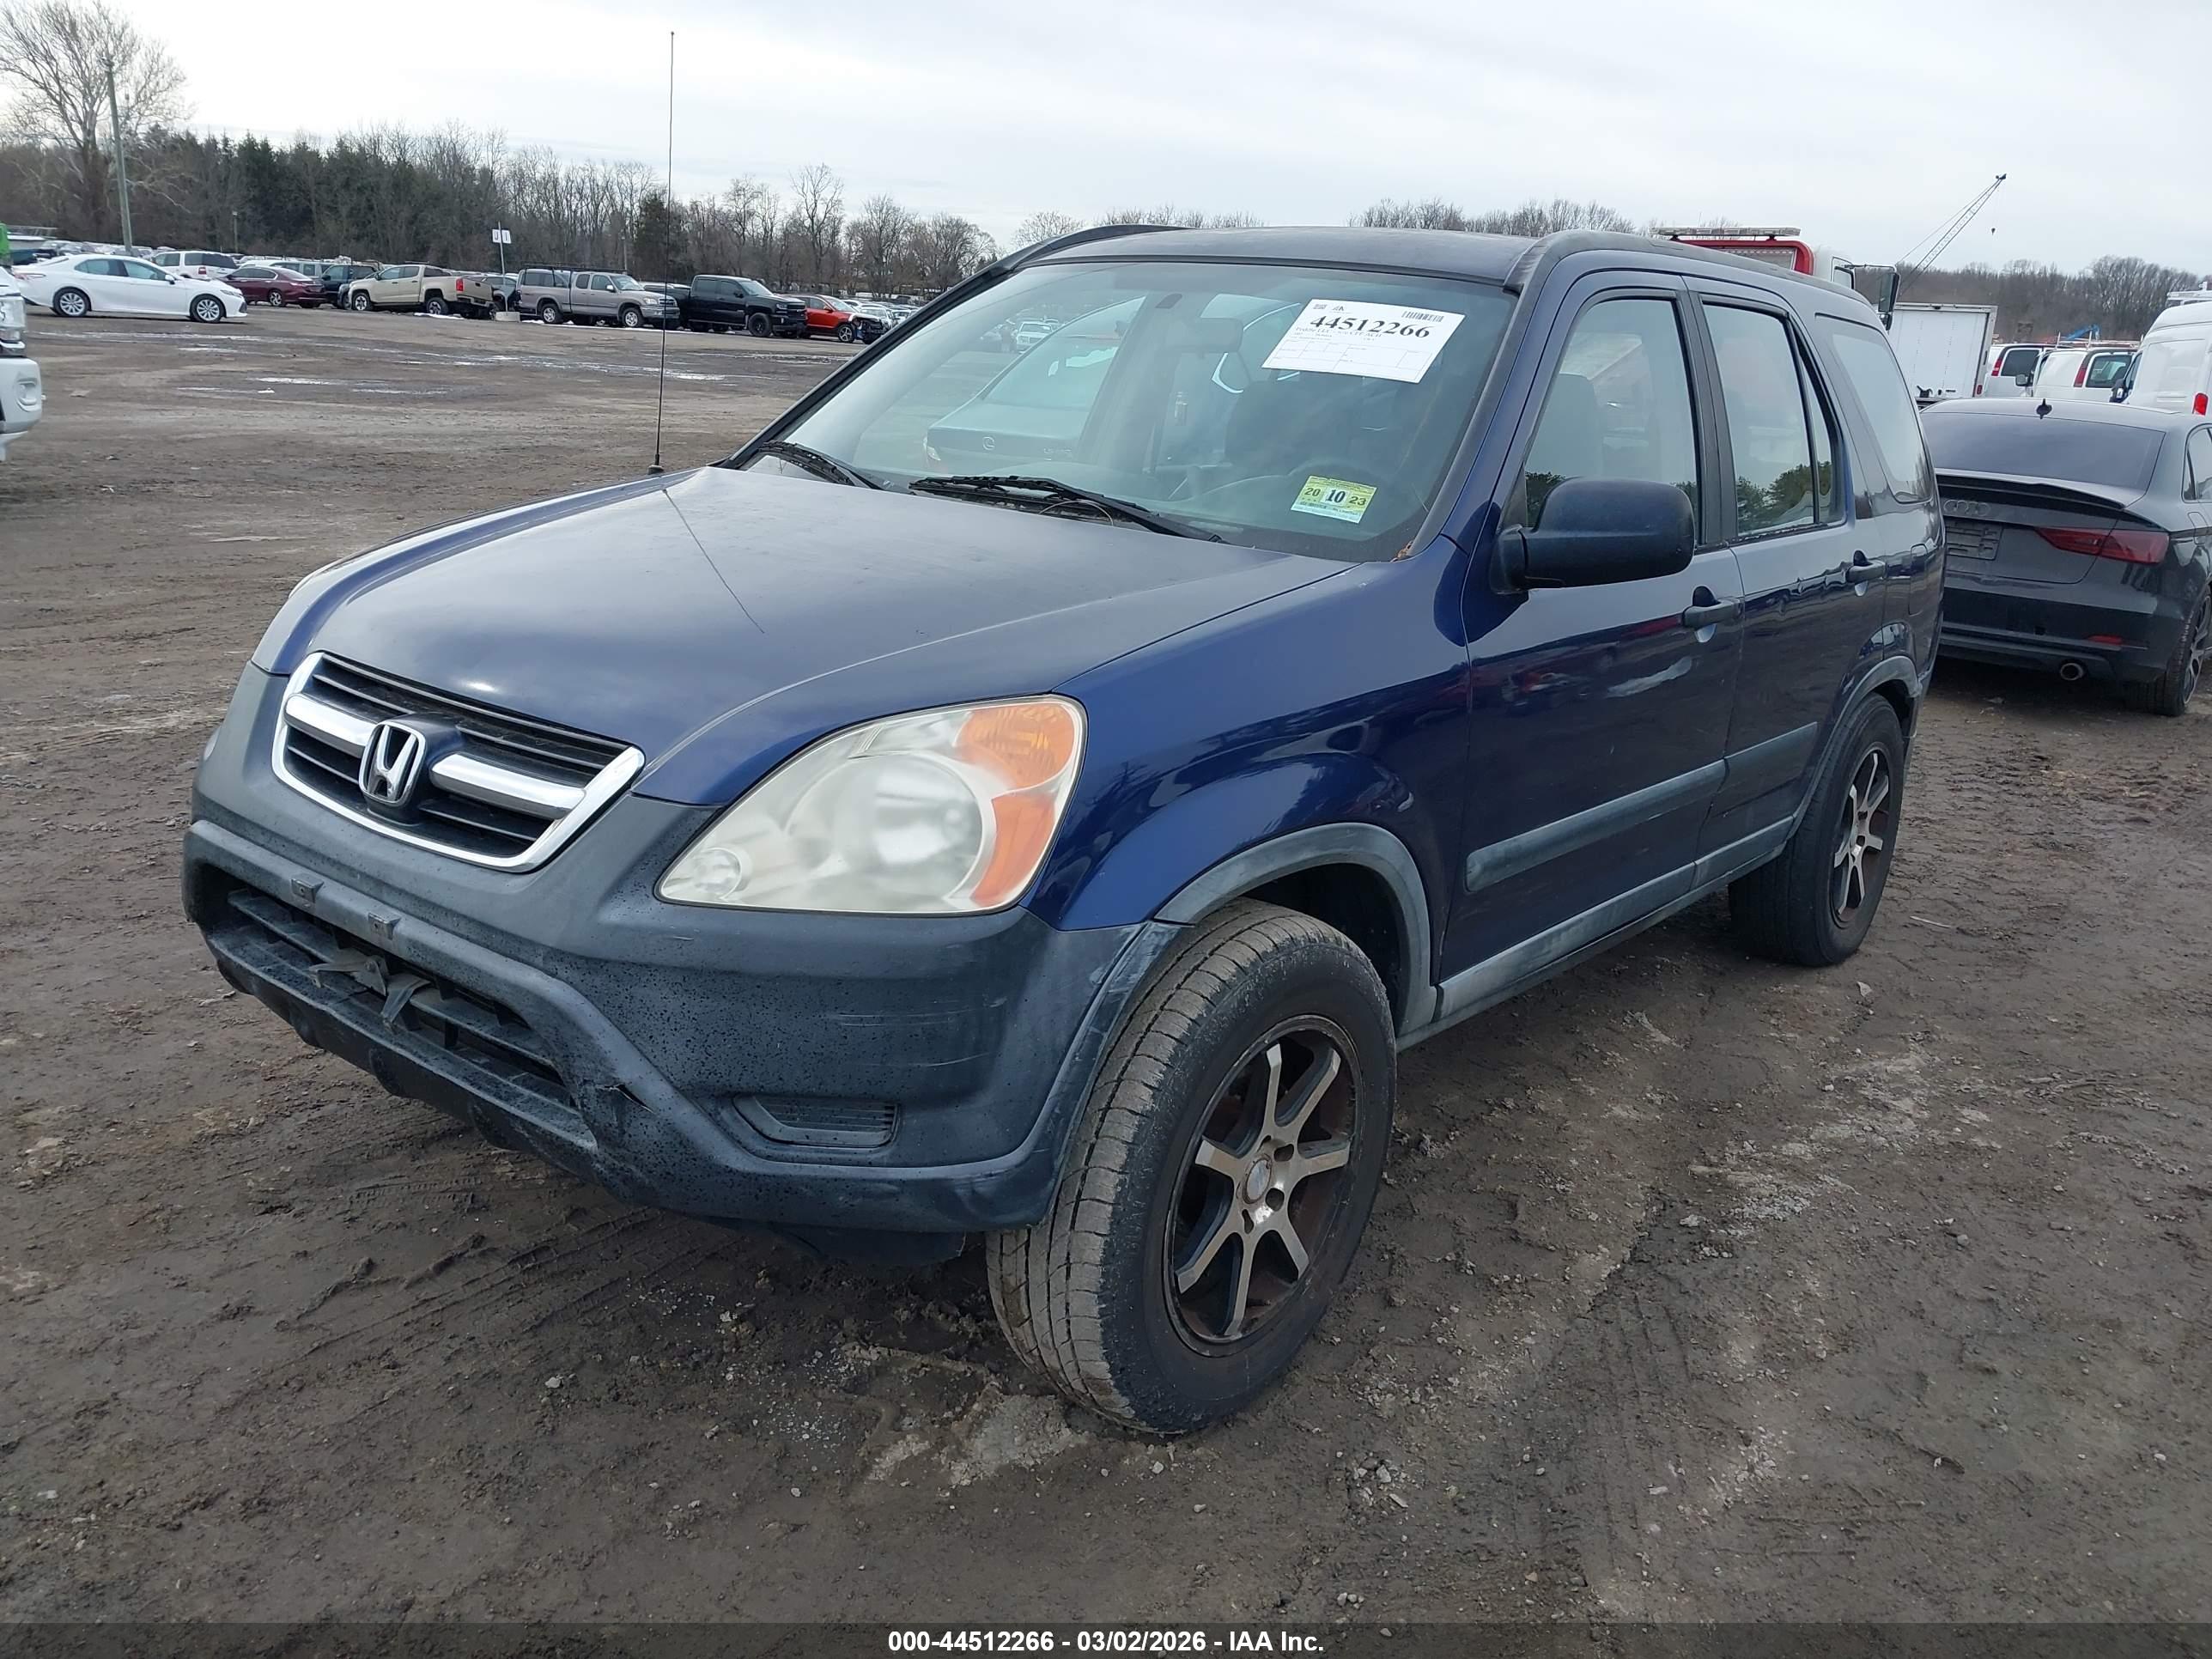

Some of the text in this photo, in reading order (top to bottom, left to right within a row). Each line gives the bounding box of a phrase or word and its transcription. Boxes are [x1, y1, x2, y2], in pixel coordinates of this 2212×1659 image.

[1310, 316, 1433, 337] 44512266
[1304, 487, 1367, 506] 20 10 23
